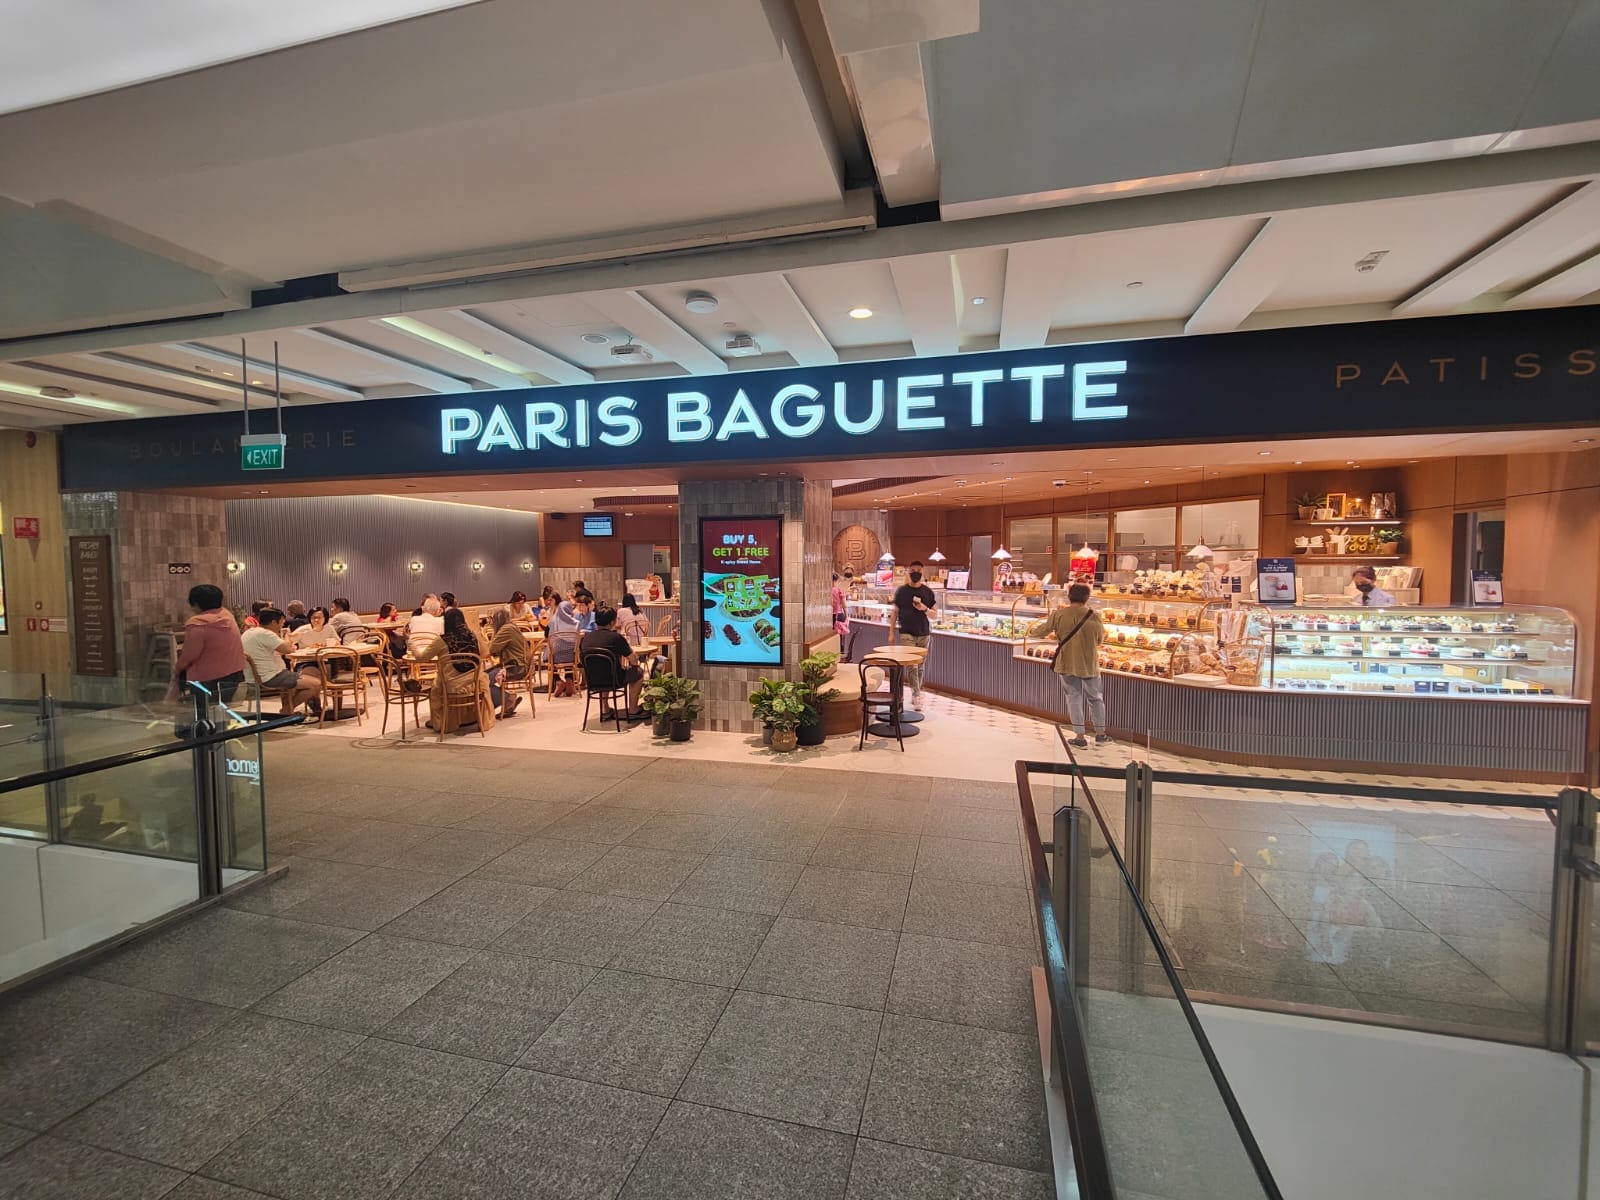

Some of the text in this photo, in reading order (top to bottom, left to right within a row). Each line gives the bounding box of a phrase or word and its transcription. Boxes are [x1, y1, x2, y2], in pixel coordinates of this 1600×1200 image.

[441, 360, 1129, 454] PARIS BAGUETTE
[253, 448, 279, 465] EXIT
[723, 534, 744, 544] BUY
[713, 547, 769, 557] GET 1 FREE
